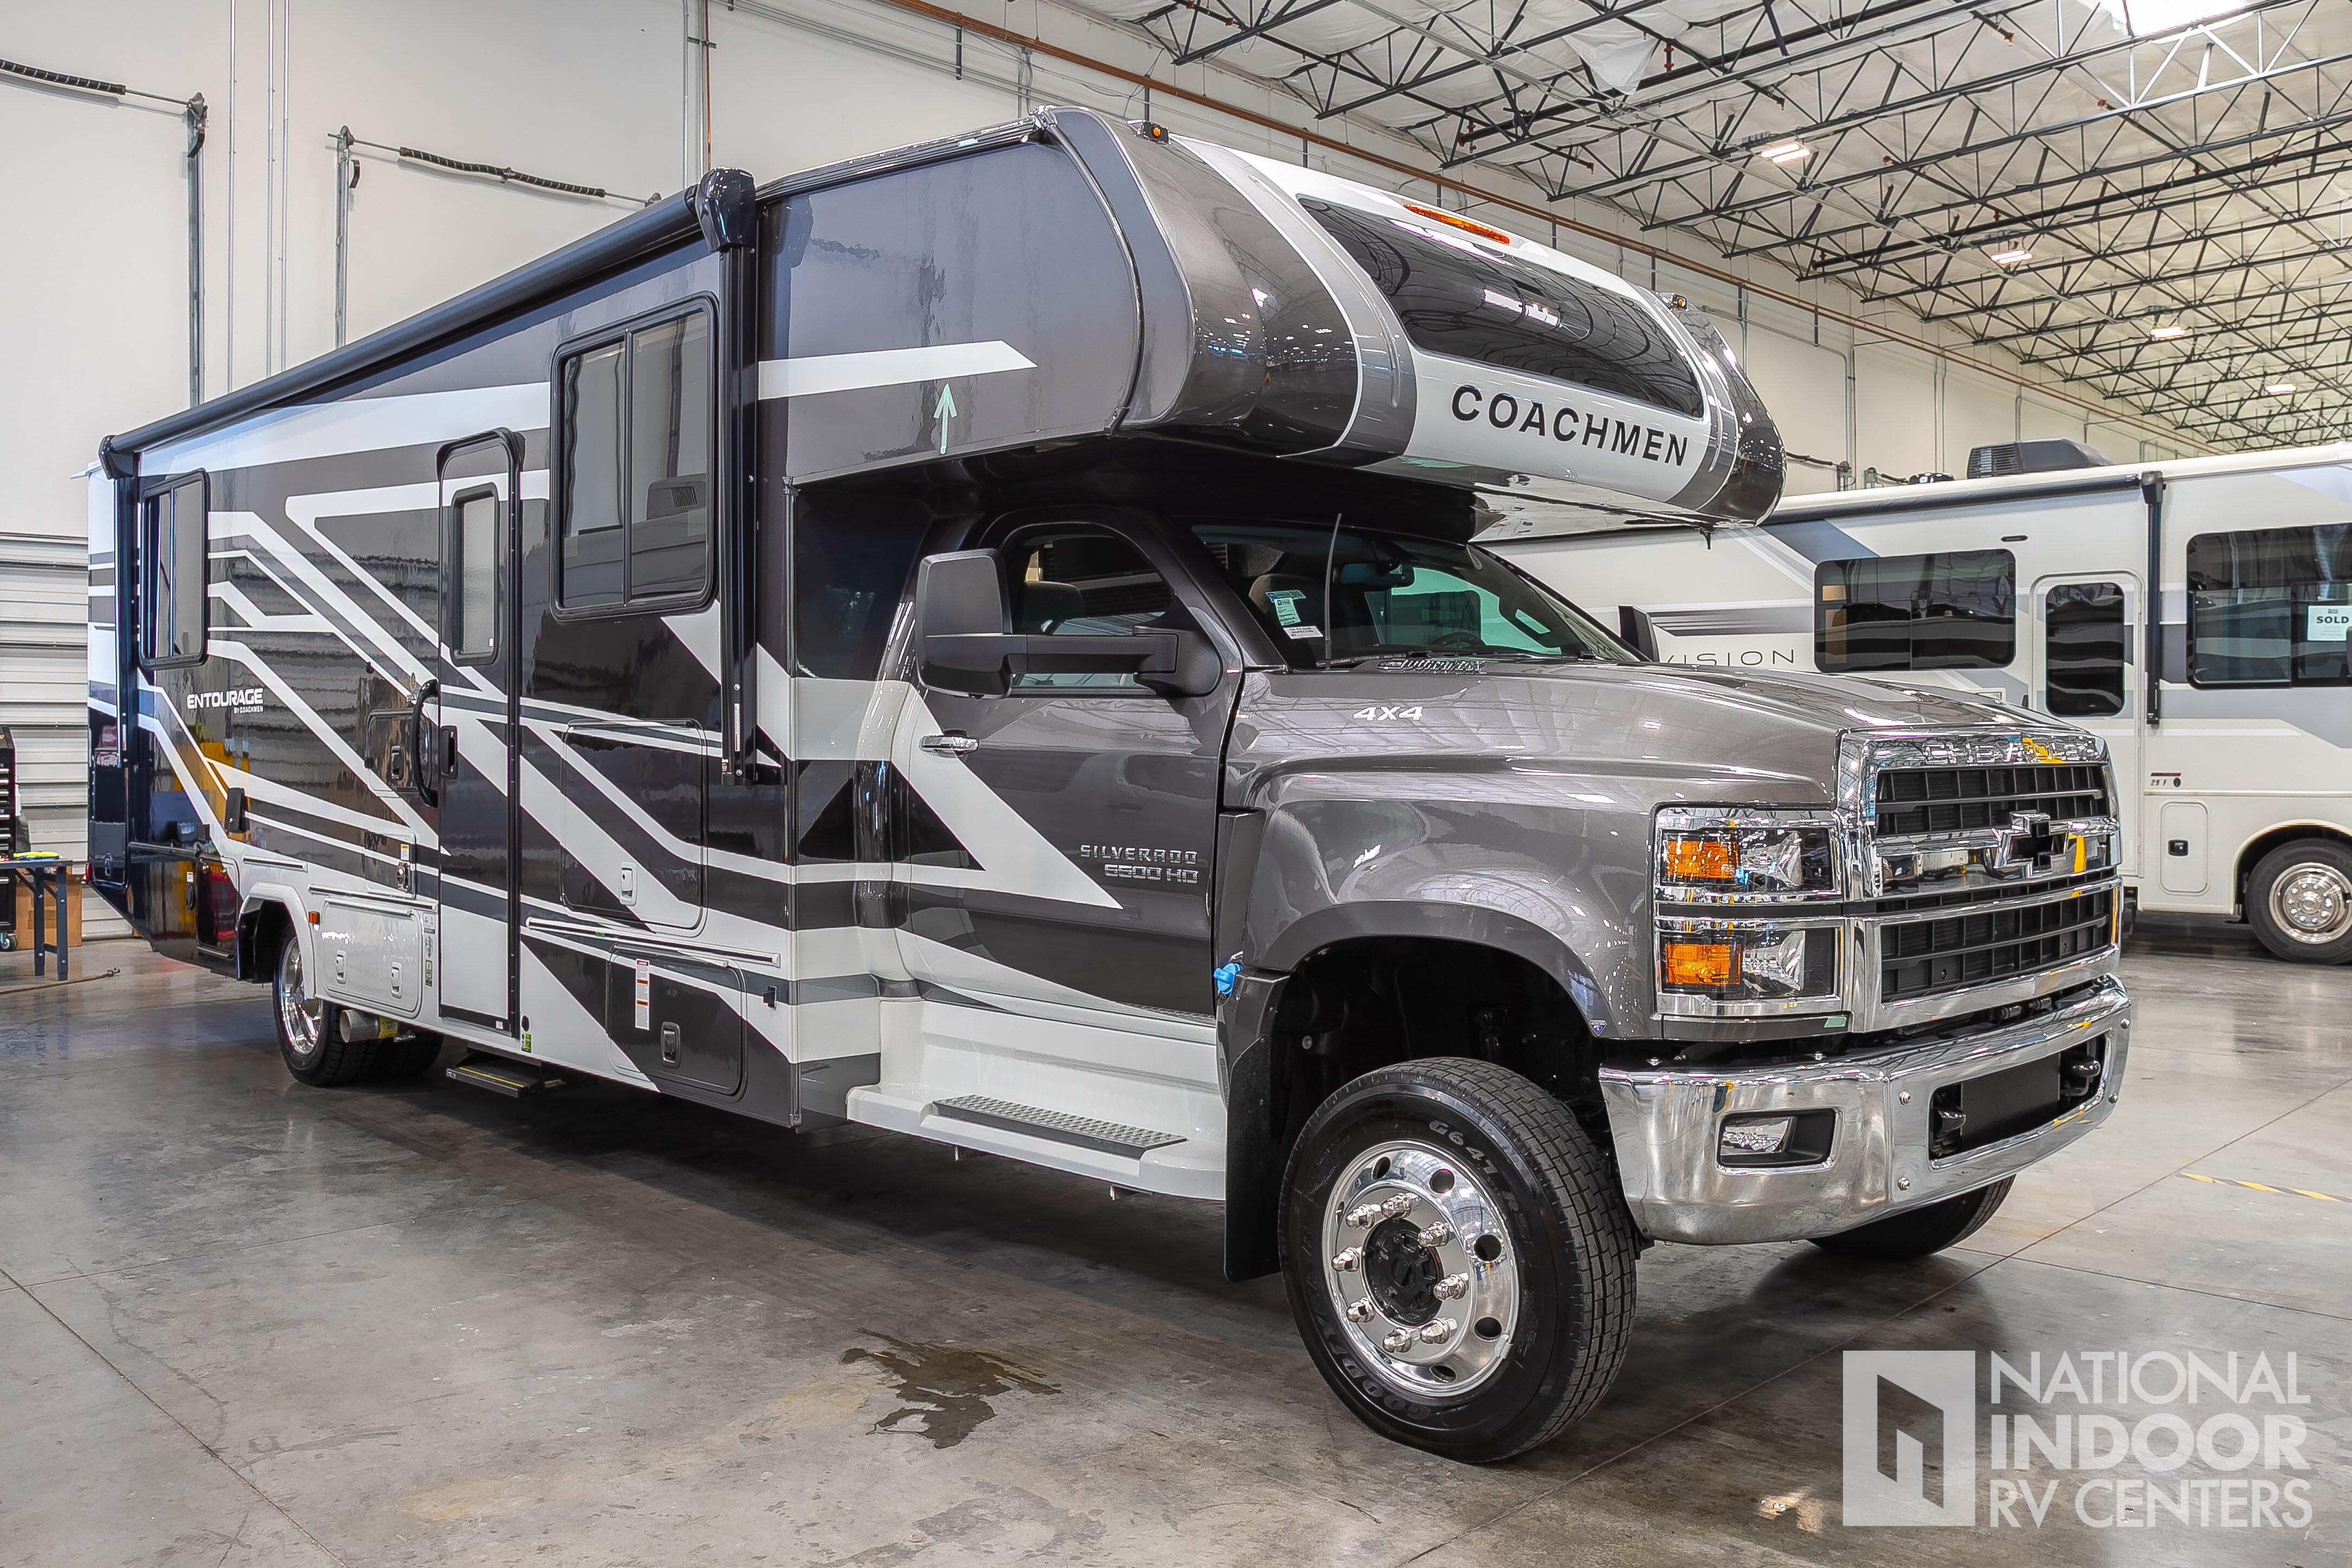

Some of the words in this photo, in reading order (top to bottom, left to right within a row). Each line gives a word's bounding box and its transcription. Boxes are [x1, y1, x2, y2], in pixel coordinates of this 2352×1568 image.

[1451, 384, 1689, 467] COACHMEN
[2316, 616, 2349, 624] SOLD
[187, 688, 263, 709] ENTOURAGE
[240, 705, 263, 713] COACHMEN
[1353, 706, 1424, 721] 4X4
[1080, 844, 1198, 864] SILVERADO
[1166, 868, 1199, 883] HD
[1429, 1120, 1498, 1174] G647
